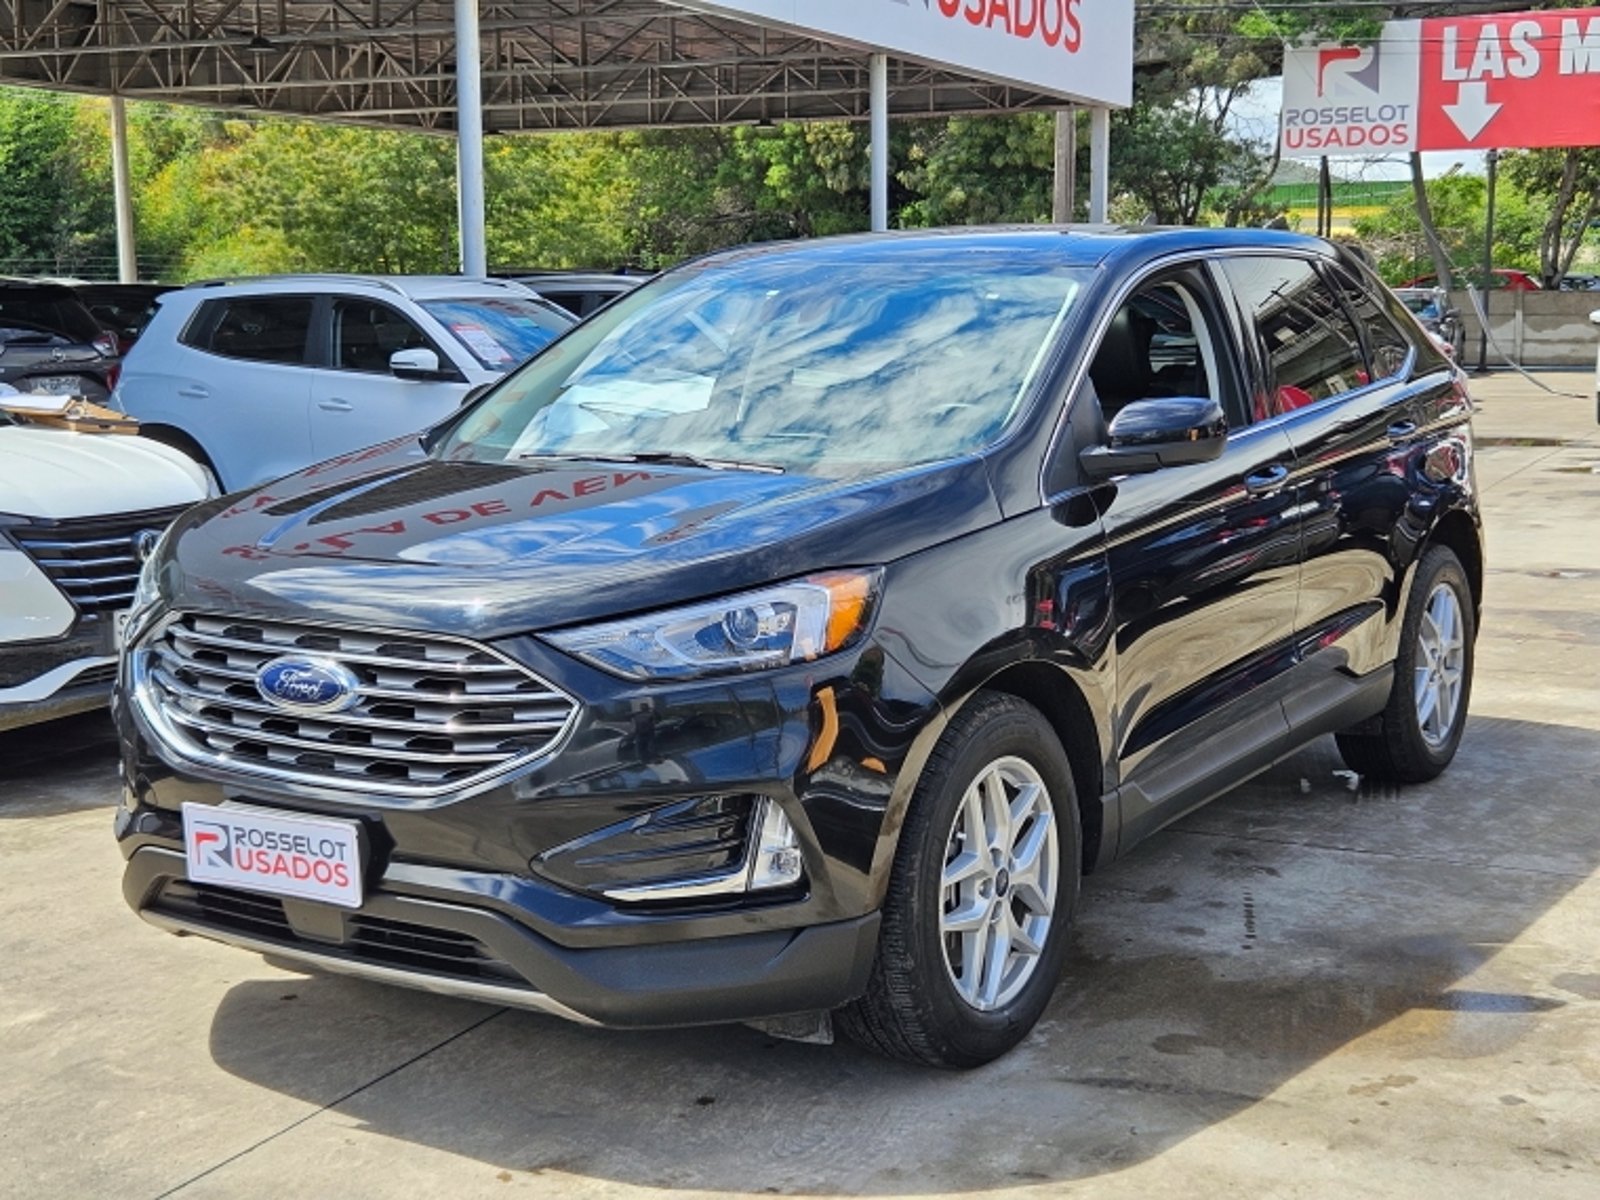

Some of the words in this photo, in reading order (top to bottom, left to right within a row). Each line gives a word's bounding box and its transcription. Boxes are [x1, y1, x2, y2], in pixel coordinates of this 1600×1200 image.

[1442, 19, 1542, 81] LAS
[1286, 104, 1410, 126] ROSSELOT
[1286, 124, 1409, 148] USADOS
[275, 668, 324, 698] Ford
[233, 827, 347, 861] ROSSELOT
[236, 848, 350, 888] USADOS
